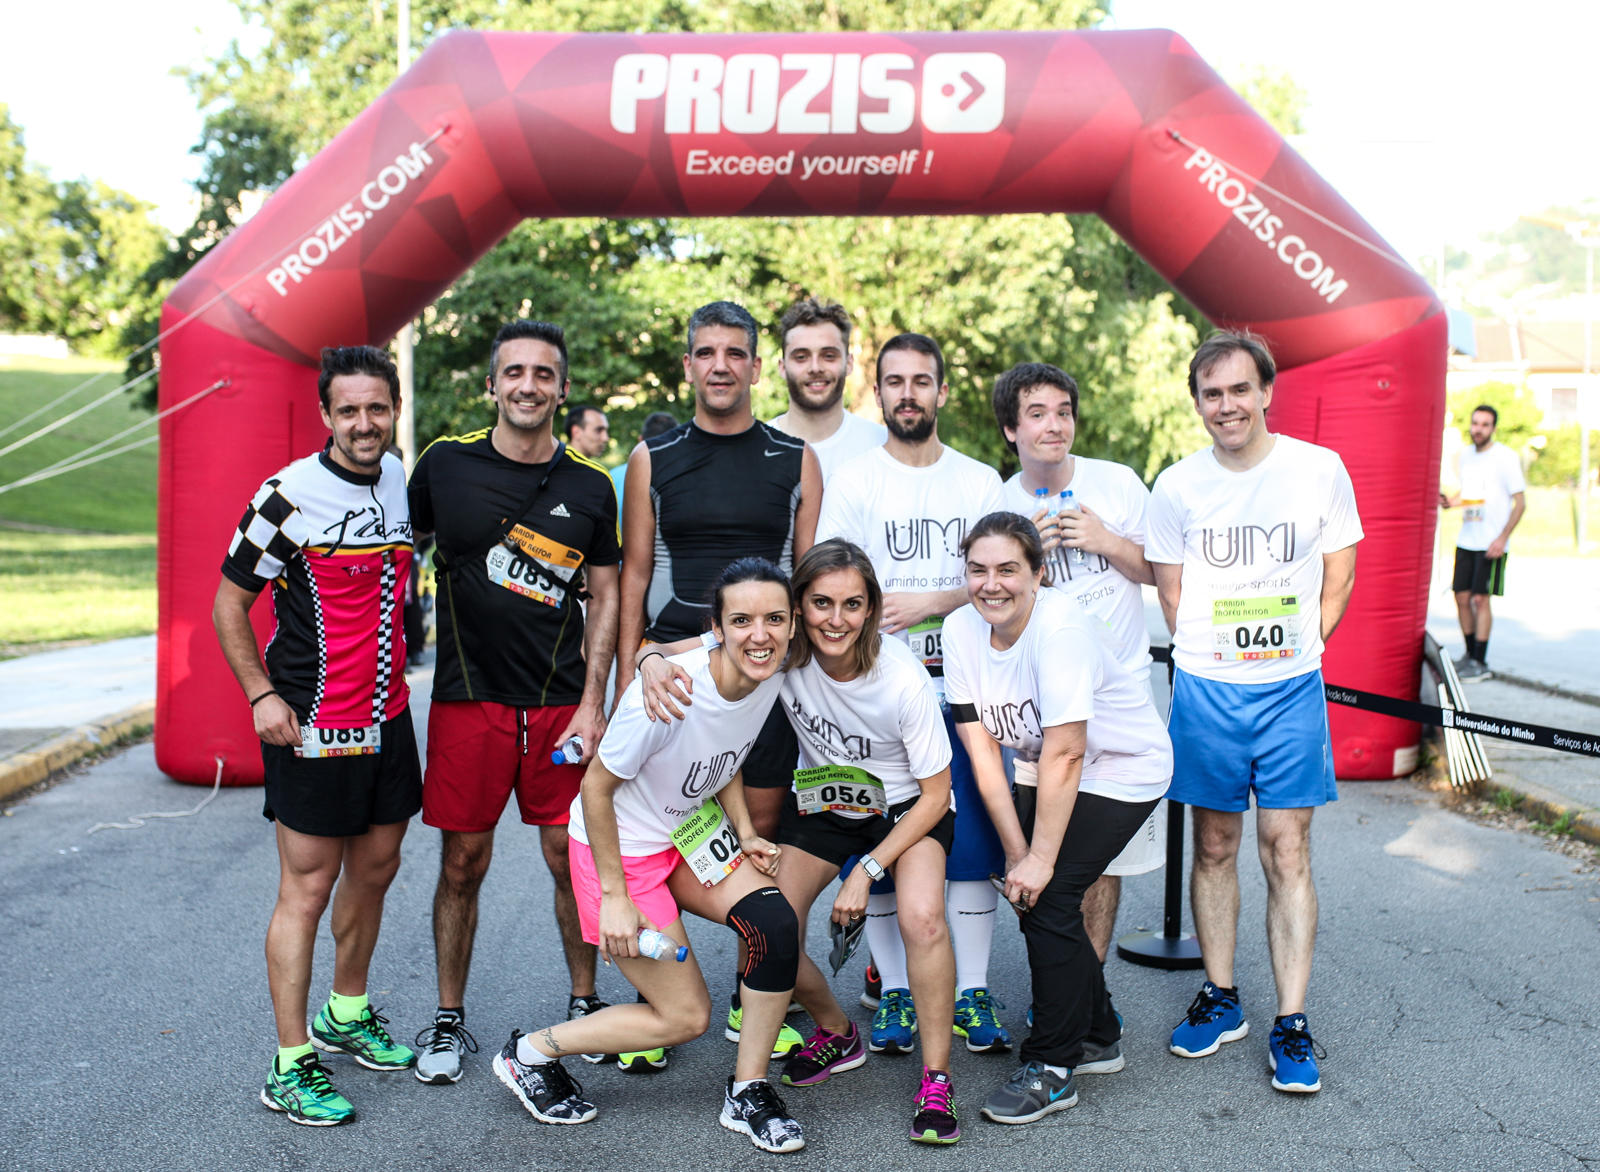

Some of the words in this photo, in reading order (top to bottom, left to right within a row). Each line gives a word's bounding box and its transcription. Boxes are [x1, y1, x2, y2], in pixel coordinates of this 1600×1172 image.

[610, 53, 915, 134] PROZIS
[685, 149, 795, 175] Exceed
[800, 149, 920, 181] yourself
[266, 142, 433, 297] PROZIS.COM
[1184, 147, 1349, 304] PROZIS.COM
[513, 526, 535, 541] RRIDA
[527, 543, 552, 559] REITOR
[885, 575, 928, 588] uminho
[931, 575, 962, 590] sports
[1250, 577, 1291, 592] sports
[1077, 585, 1115, 606] sports
[1214, 600, 1245, 608] CORRIDA
[1243, 608, 1269, 617] REITOR
[925, 634, 943, 657] 05
[1235, 624, 1284, 649] 040
[319, 728, 366, 745] 085
[1455, 716, 1500, 734] Universidade
[1501, 725, 1511, 736] do
[1512, 726, 1535, 741] Minho
[1553, 734, 1582, 750] Serviços
[1582, 740, 1592, 751] de
[797, 766, 830, 777] CORRIDA
[828, 772, 855, 780] REITOR
[821, 785, 872, 805] 056
[673, 815, 703, 840] CORRIDA
